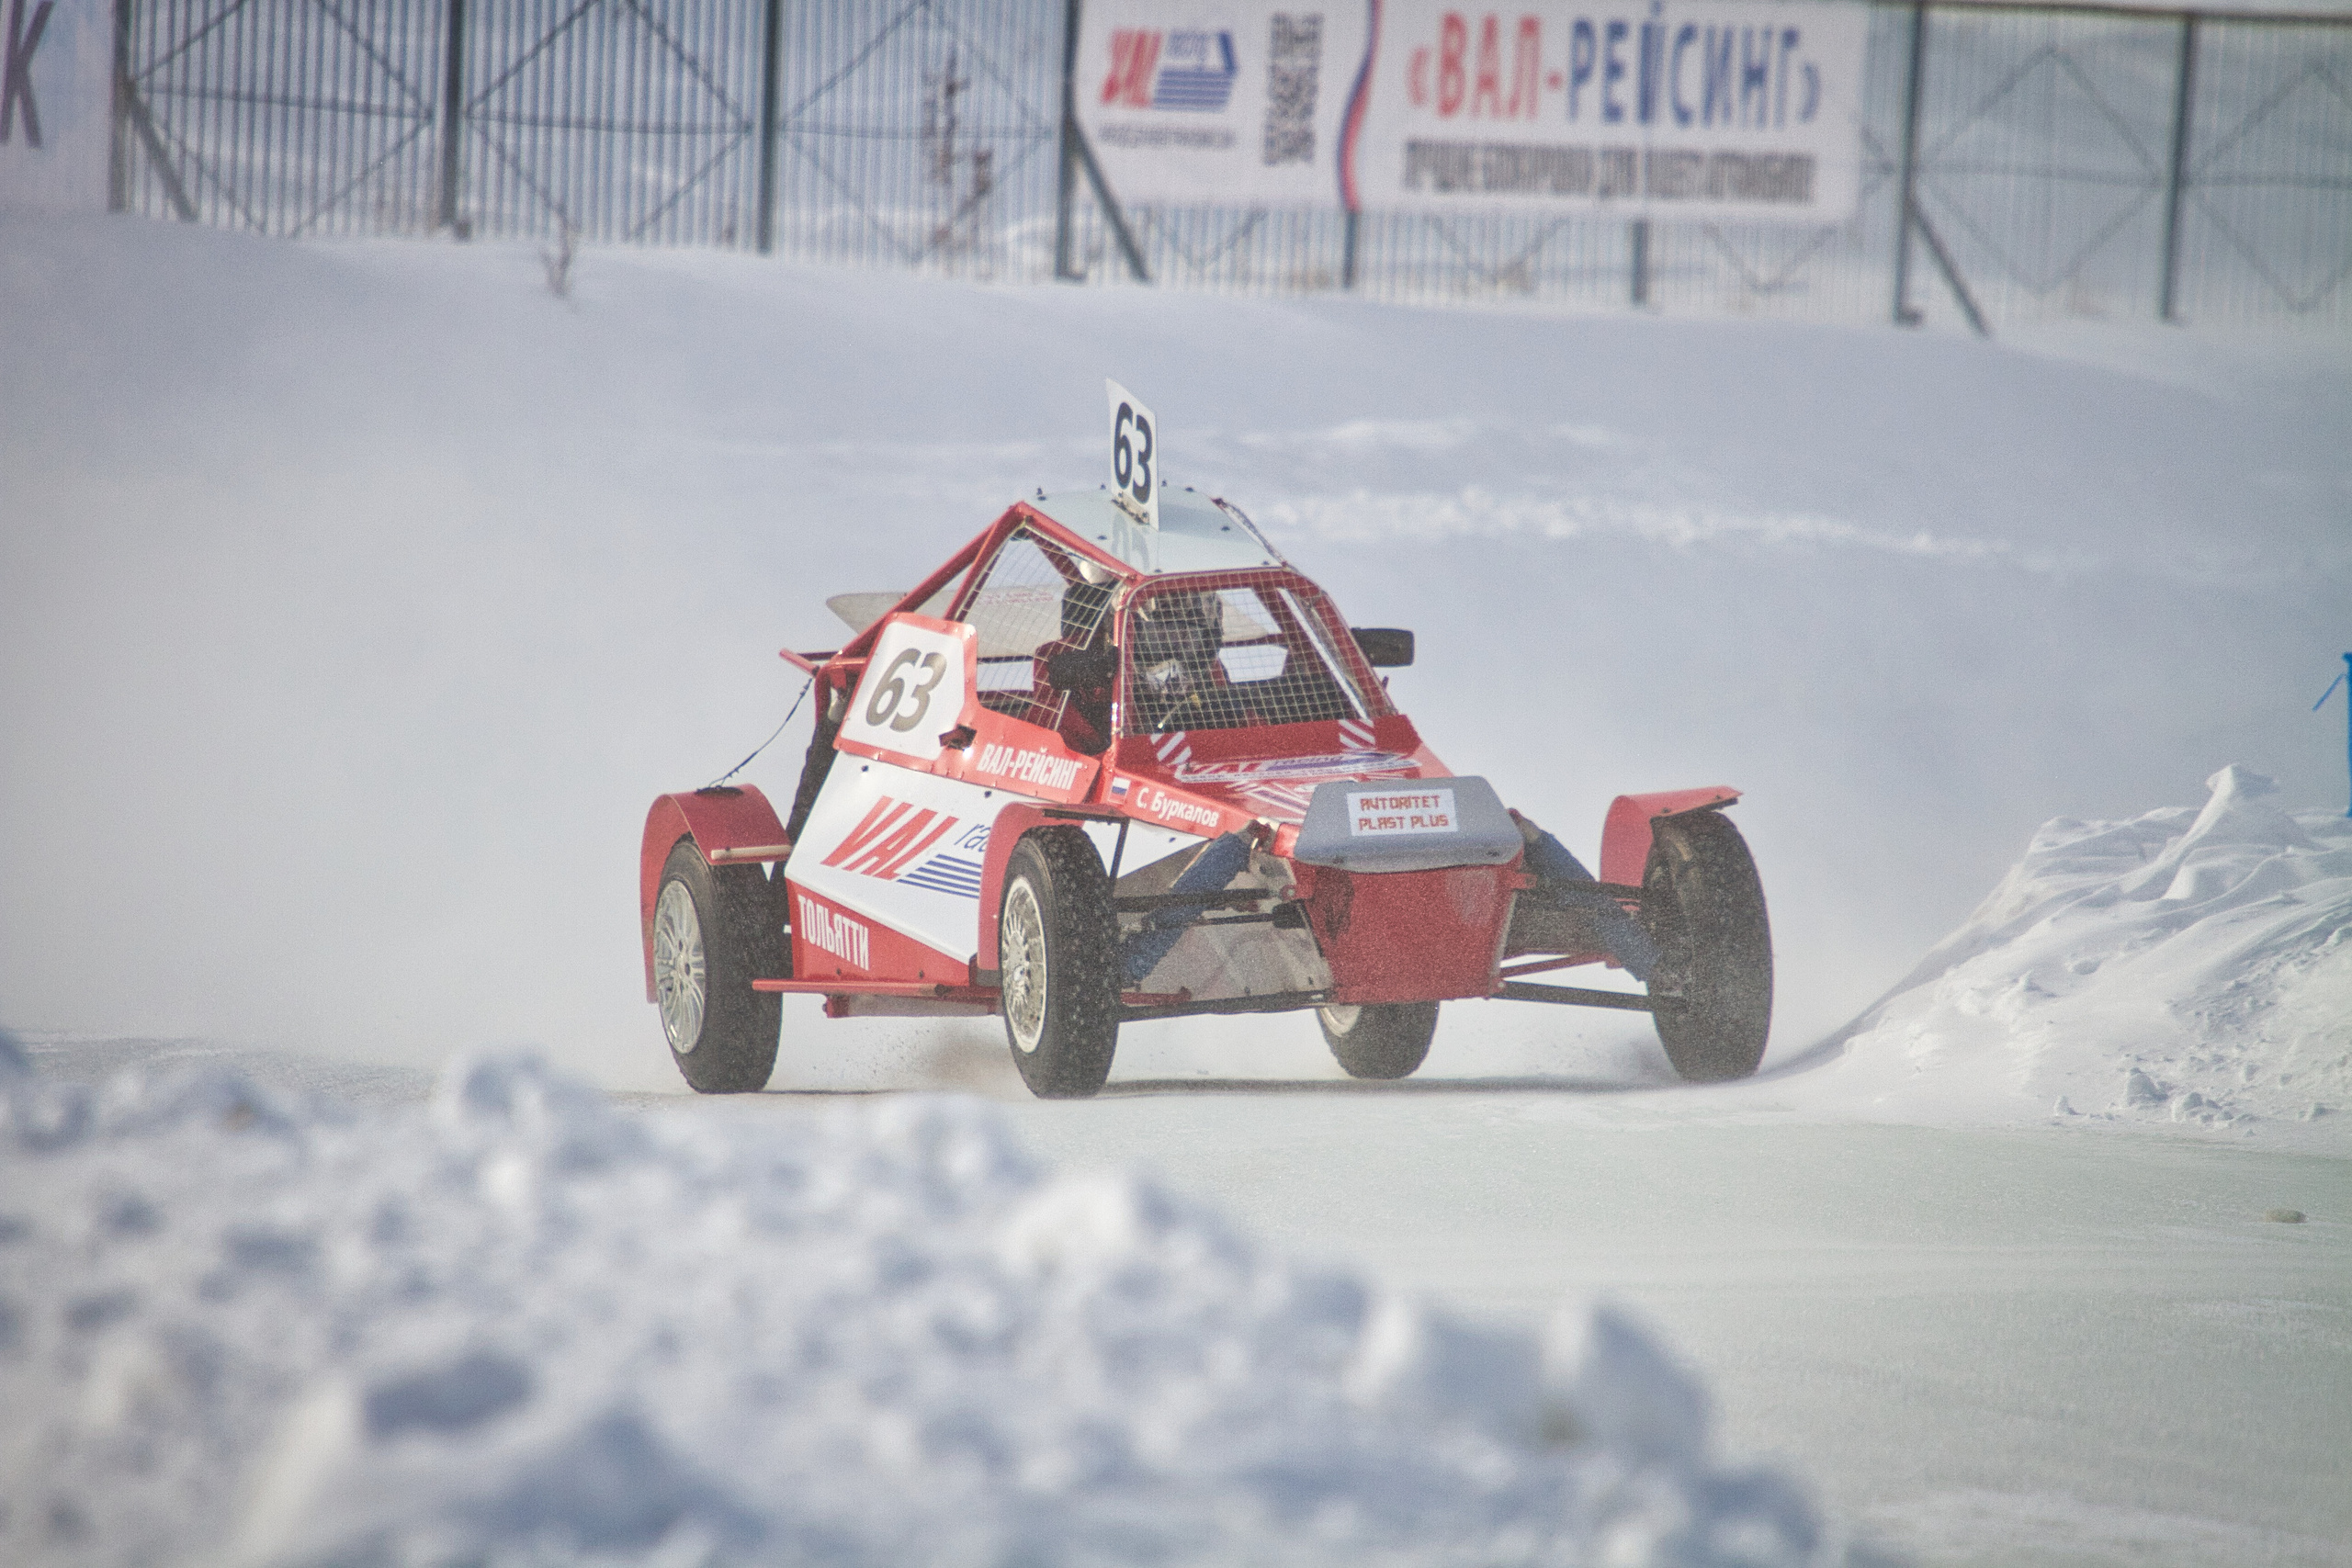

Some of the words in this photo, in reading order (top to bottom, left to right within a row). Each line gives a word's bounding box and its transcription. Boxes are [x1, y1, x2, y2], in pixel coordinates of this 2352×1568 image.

[1114, 401, 1153, 504] 63
[865, 648, 947, 733] 63
[976, 743, 1083, 790] ВАЛ-РЕЙСИНГ
[820, 795, 960, 880] VAL
[1136, 787, 1149, 809] С.
[1150, 791, 1219, 828] Буркалов
[1358, 816, 1405, 831] PLAST
[1409, 814, 1449, 829] PLUS
[797, 894, 870, 972] ТОЛЬЯТТИ
